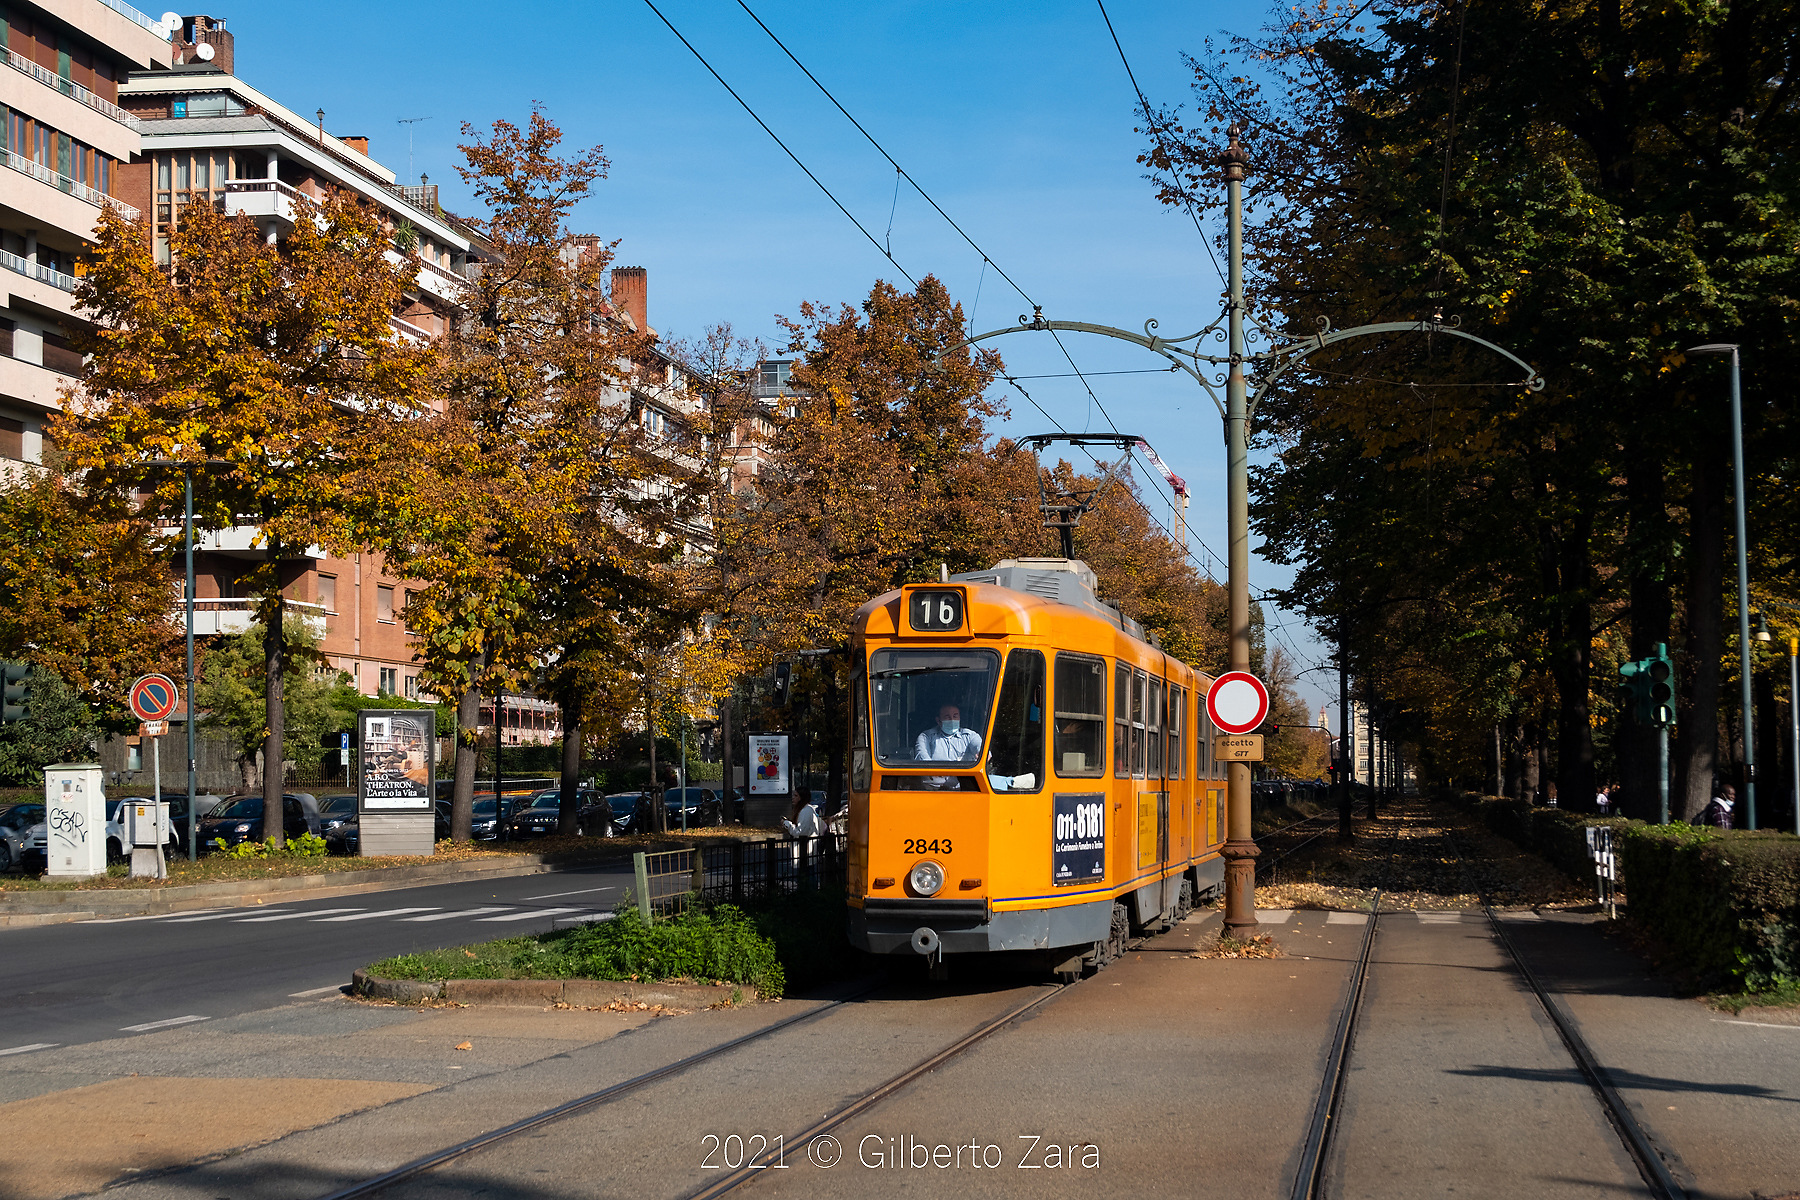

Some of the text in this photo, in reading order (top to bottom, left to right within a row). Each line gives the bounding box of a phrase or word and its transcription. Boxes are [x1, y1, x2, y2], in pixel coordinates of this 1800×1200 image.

[921, 594, 954, 625] 16
[1221, 739, 1254, 747] eccetto
[395, 789, 402, 797] la
[402, 789, 418, 797] Vita
[1056, 803, 1104, 841] 011-8181
[903, 838, 953, 855] 2843
